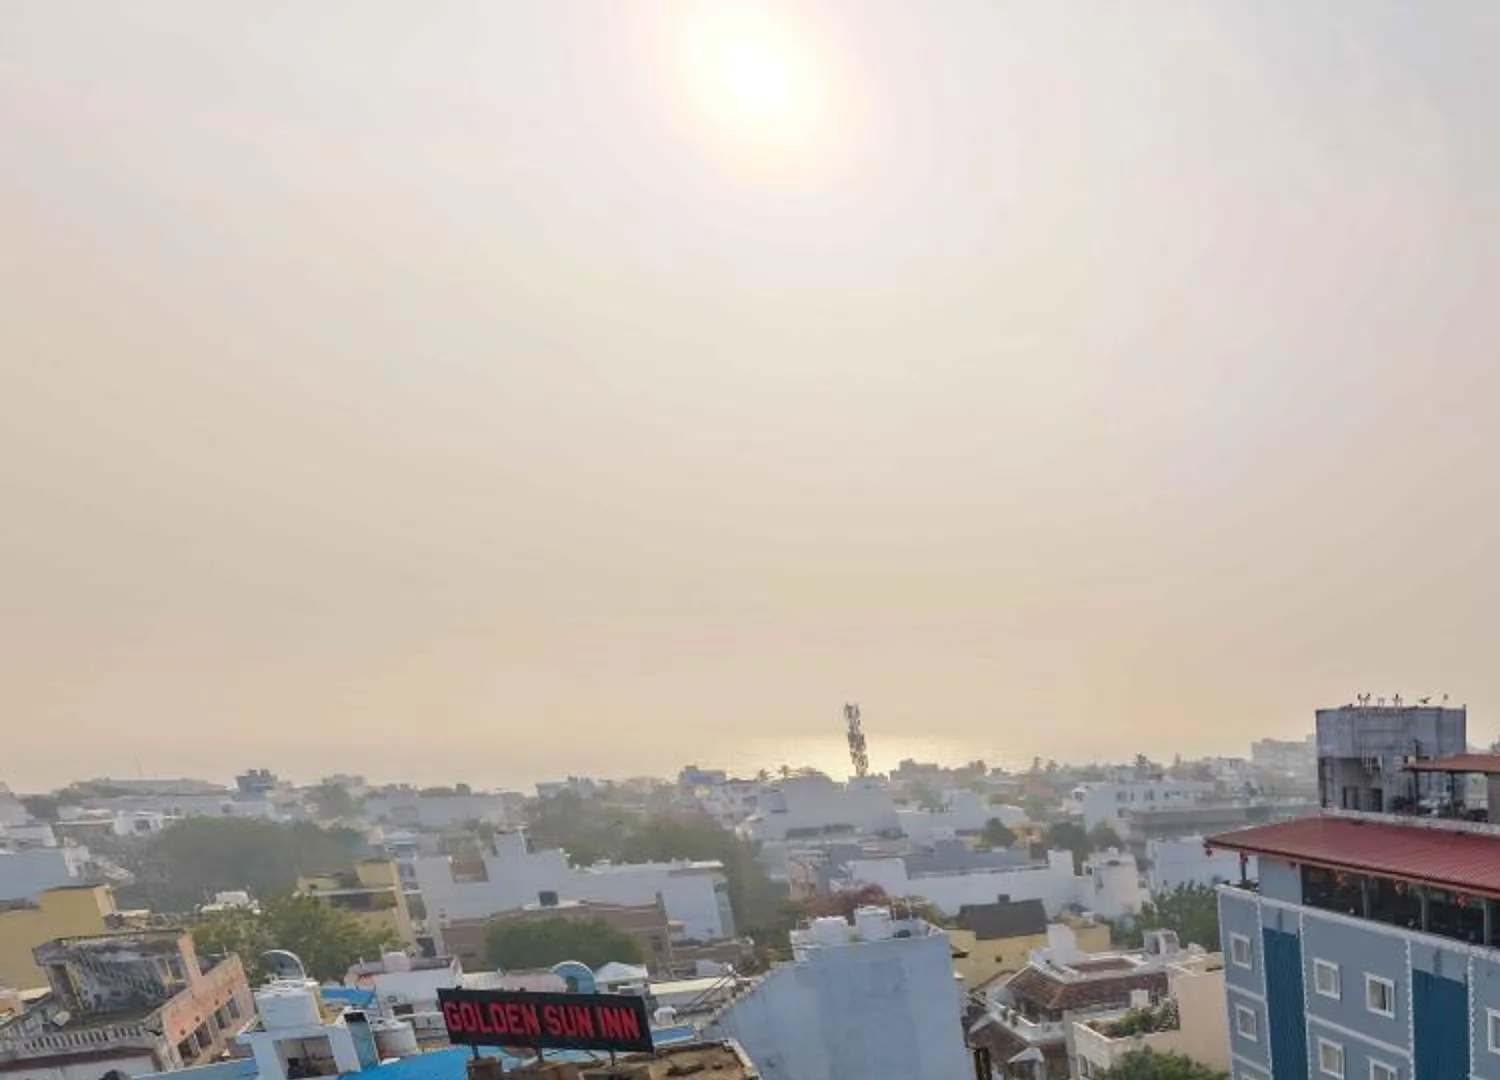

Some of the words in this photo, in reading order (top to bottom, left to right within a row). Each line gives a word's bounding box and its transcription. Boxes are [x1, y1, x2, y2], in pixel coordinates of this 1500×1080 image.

[443, 1000, 541, 1035] GOLDEN
[543, 1005, 595, 1038] SUN
[597, 1007, 641, 1040] INN
